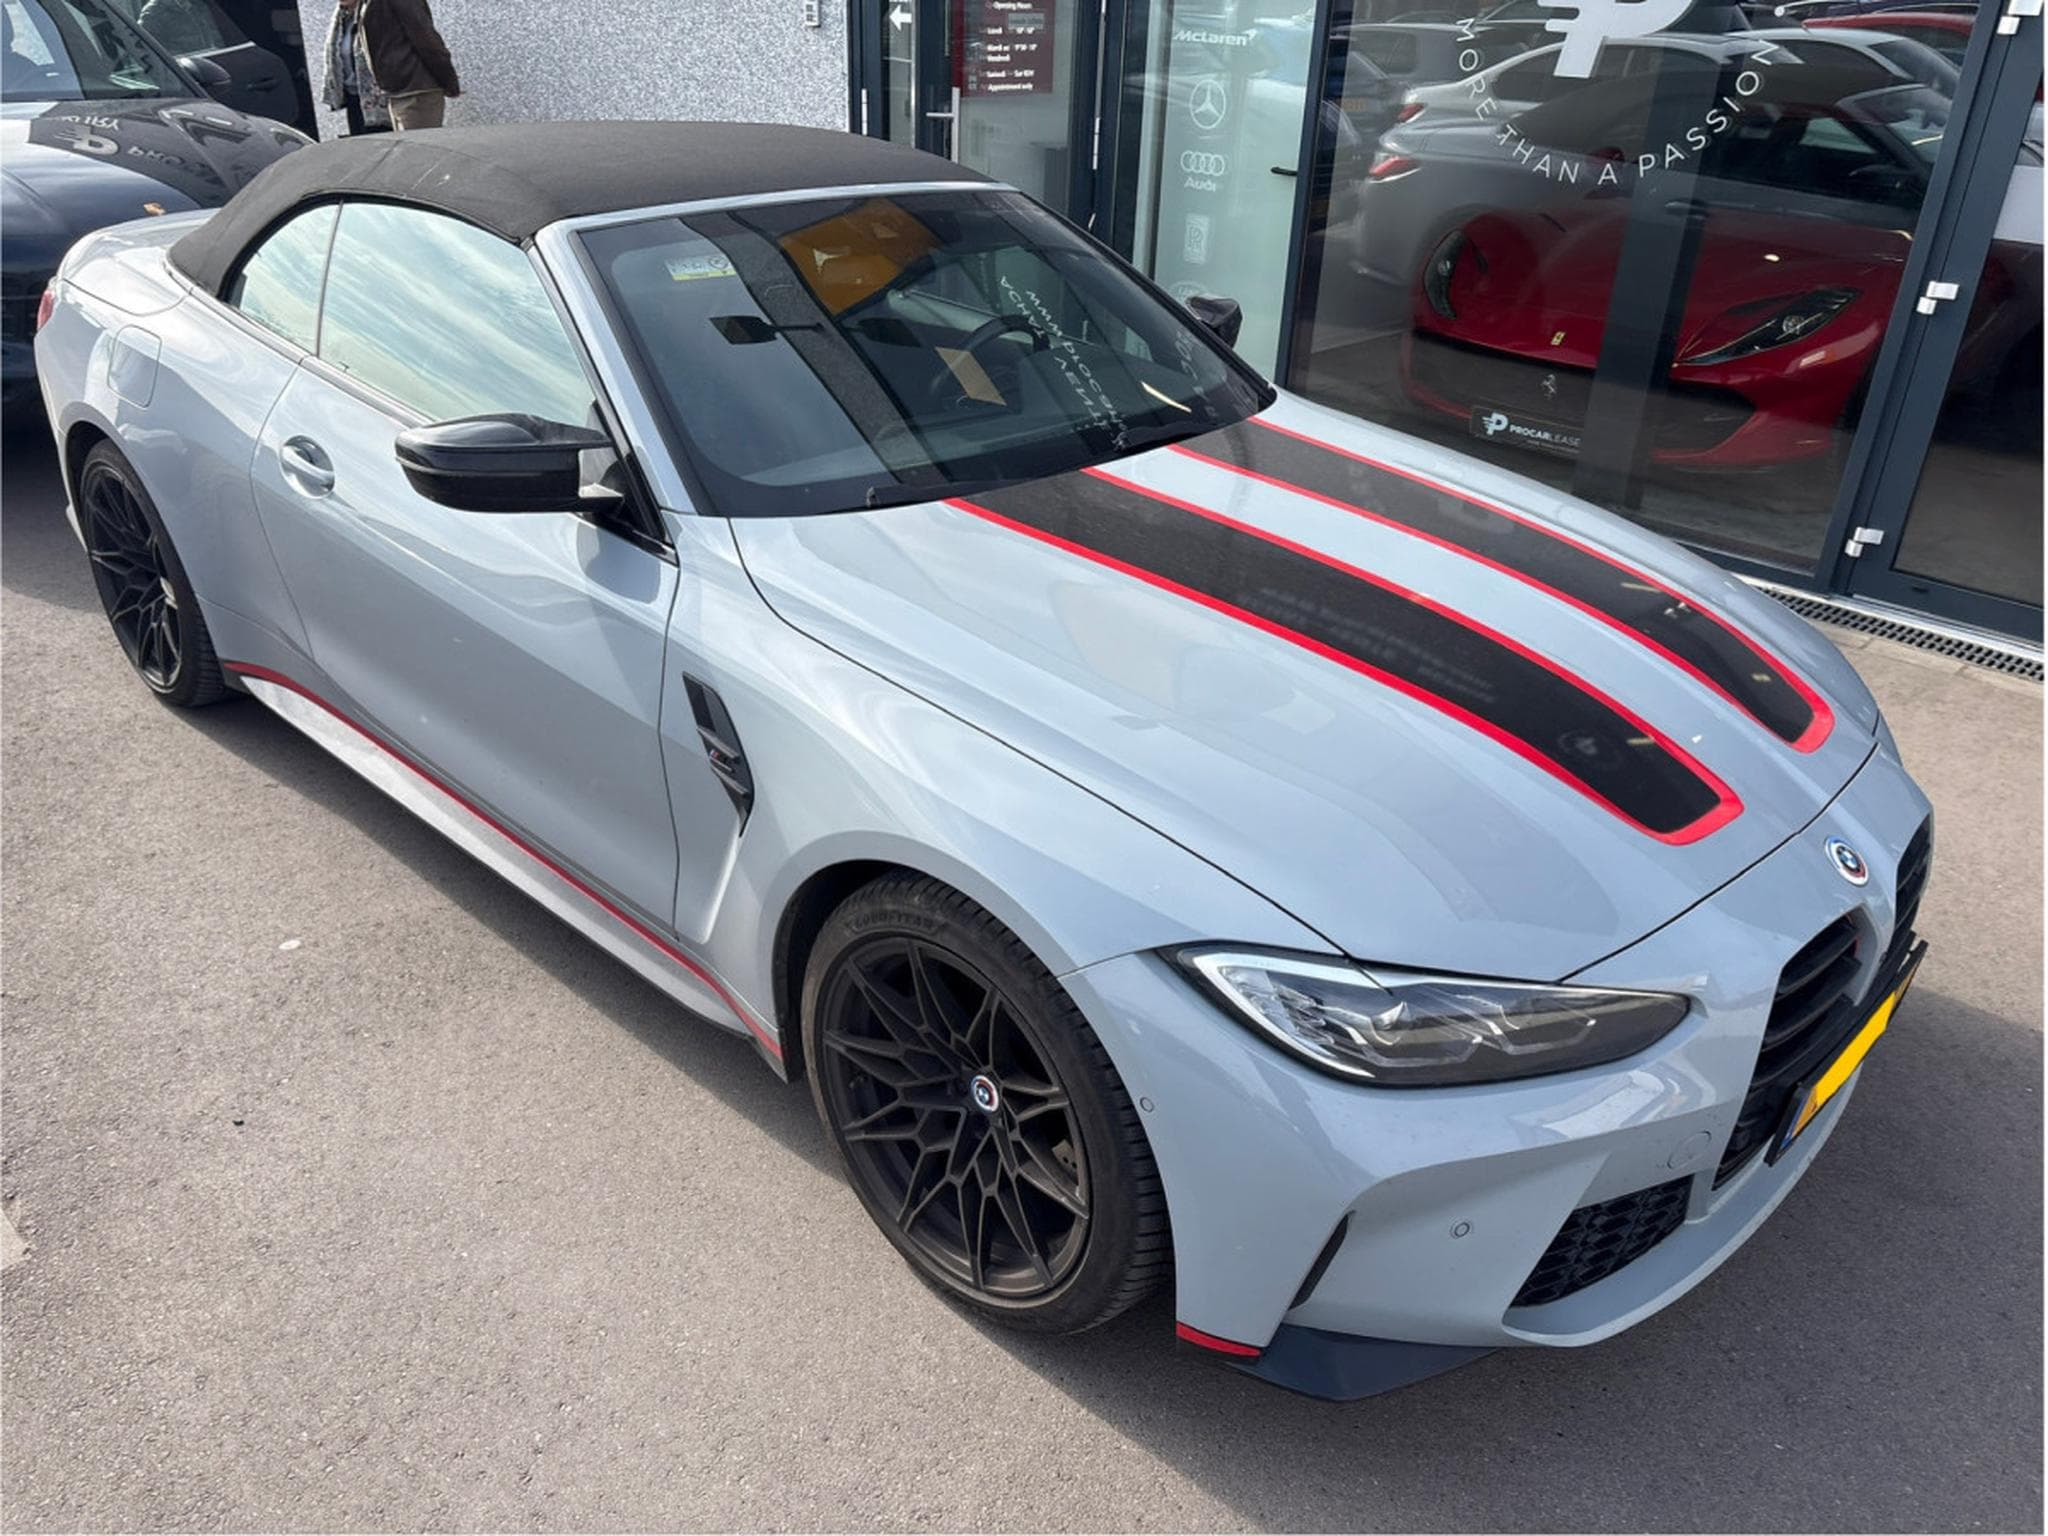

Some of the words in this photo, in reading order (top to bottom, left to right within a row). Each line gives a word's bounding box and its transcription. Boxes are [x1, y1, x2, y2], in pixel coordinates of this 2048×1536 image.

[1172, 29, 1248, 46] McLaren
[1456, 17, 1497, 121] MORE
[1496, 124, 1580, 184] THAN
[1598, 163, 1618, 185] A
[1638, 39, 1779, 177] PASSION
[1184, 176, 1216, 192] Audi
[1509, 424, 1581, 448] PROCARLEASE
